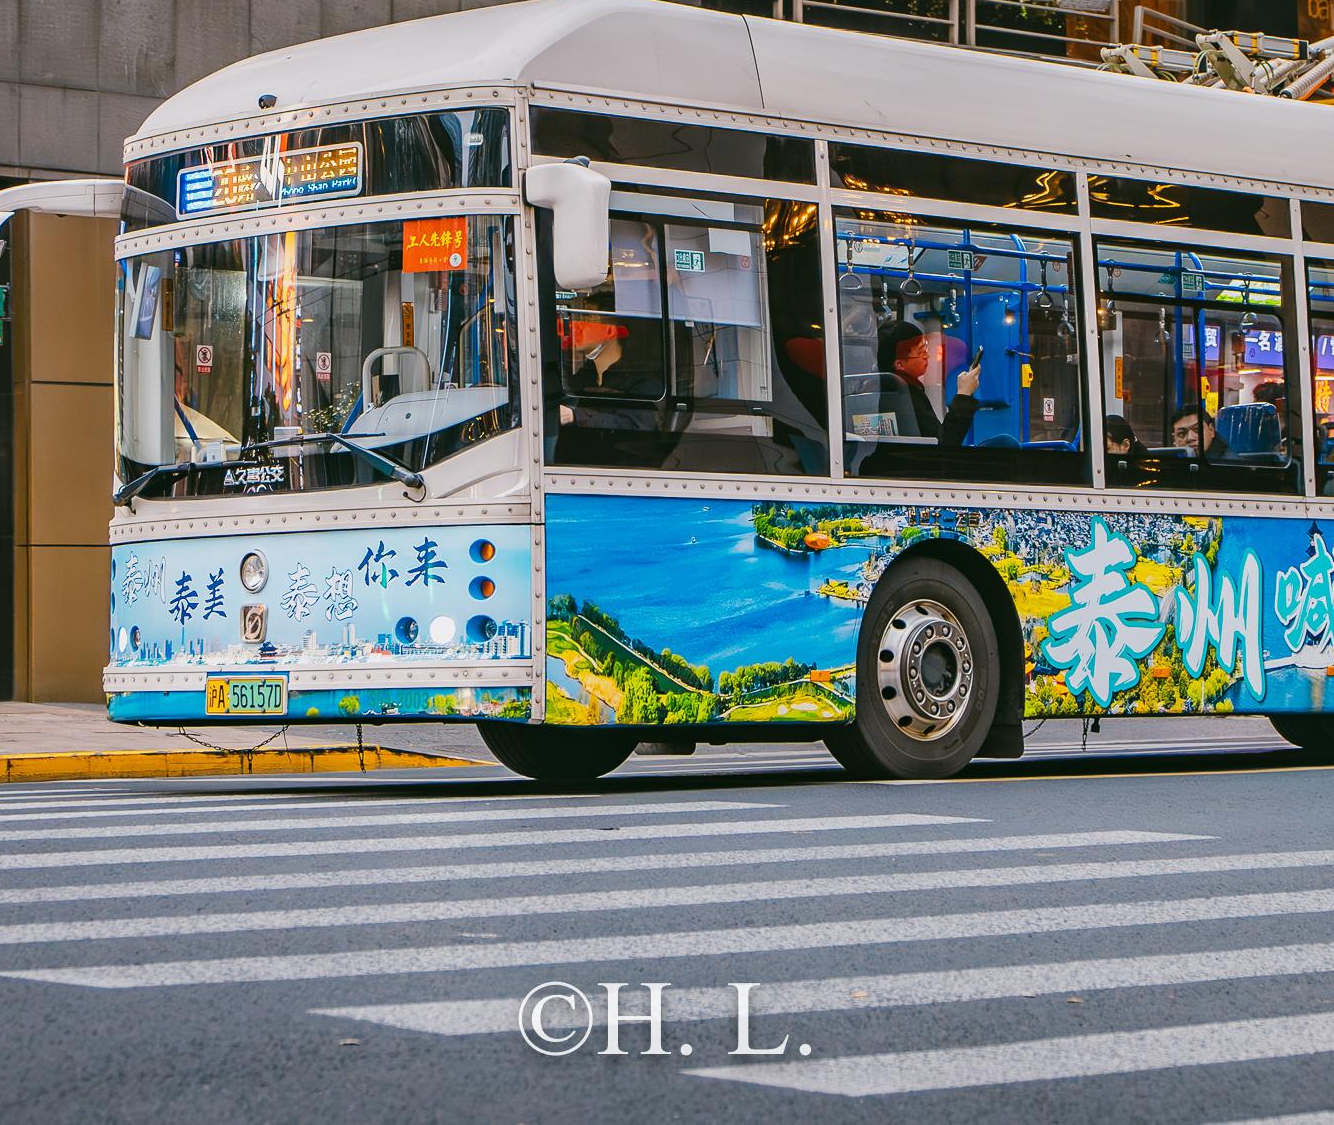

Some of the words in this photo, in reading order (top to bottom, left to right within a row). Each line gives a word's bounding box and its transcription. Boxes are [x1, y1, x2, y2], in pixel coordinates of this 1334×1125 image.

[406, 230, 463, 251] 工人先锋号
[1046, 514, 1266, 708] 泰州
